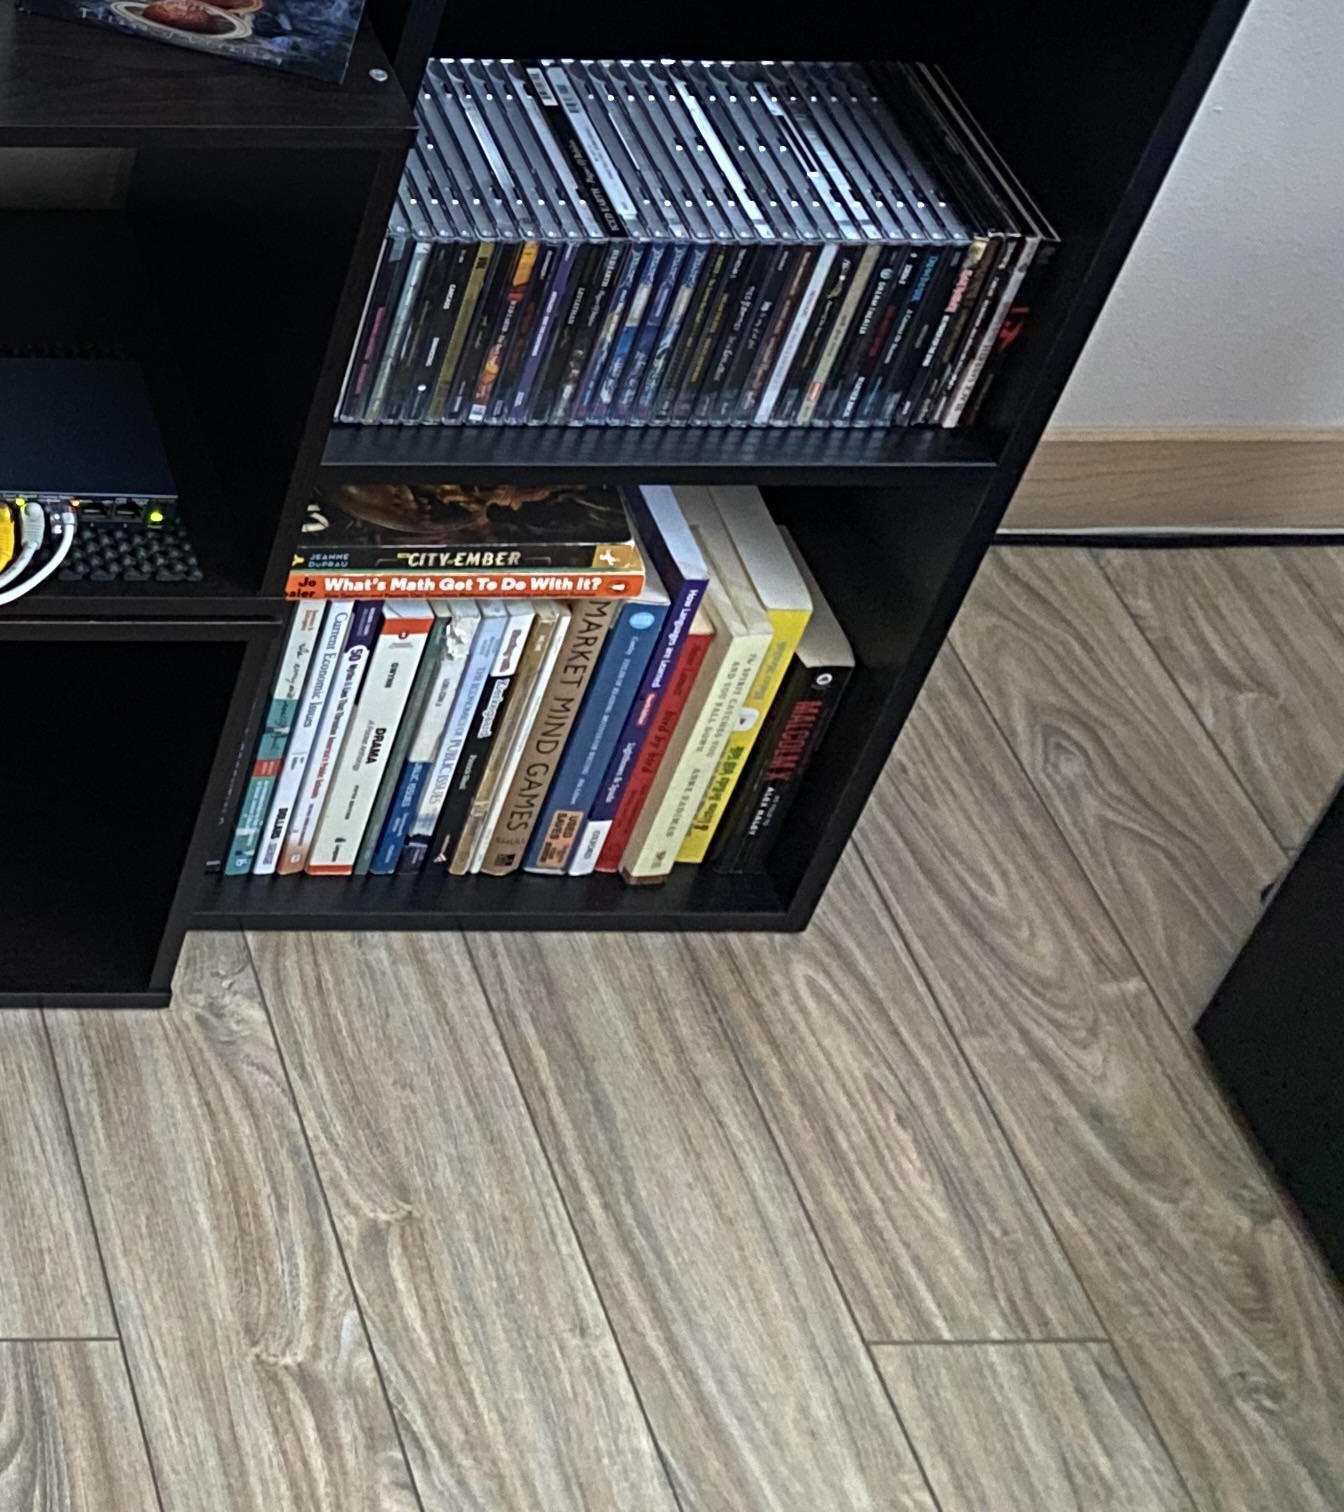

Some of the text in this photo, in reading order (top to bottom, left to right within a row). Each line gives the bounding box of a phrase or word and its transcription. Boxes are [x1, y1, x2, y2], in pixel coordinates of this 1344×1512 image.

[408, 551, 521, 568] CITY EMBER
[298, 578, 317, 587] Jo
[325, 577, 603, 592] What's Math Got To Do With It?
[349, 648, 364, 662] 50
[561, 600, 611, 689] MARKET
[303, 611, 349, 728] Current Economic Issues
[536, 696, 571, 755] MIND
[769, 700, 824, 769] MALCOLM
[365, 728, 387, 764] DRAMA
[441, 738, 463, 772] PUBLIC
[428, 772, 448, 805] ISSUES
[507, 765, 550, 832] GAMES
